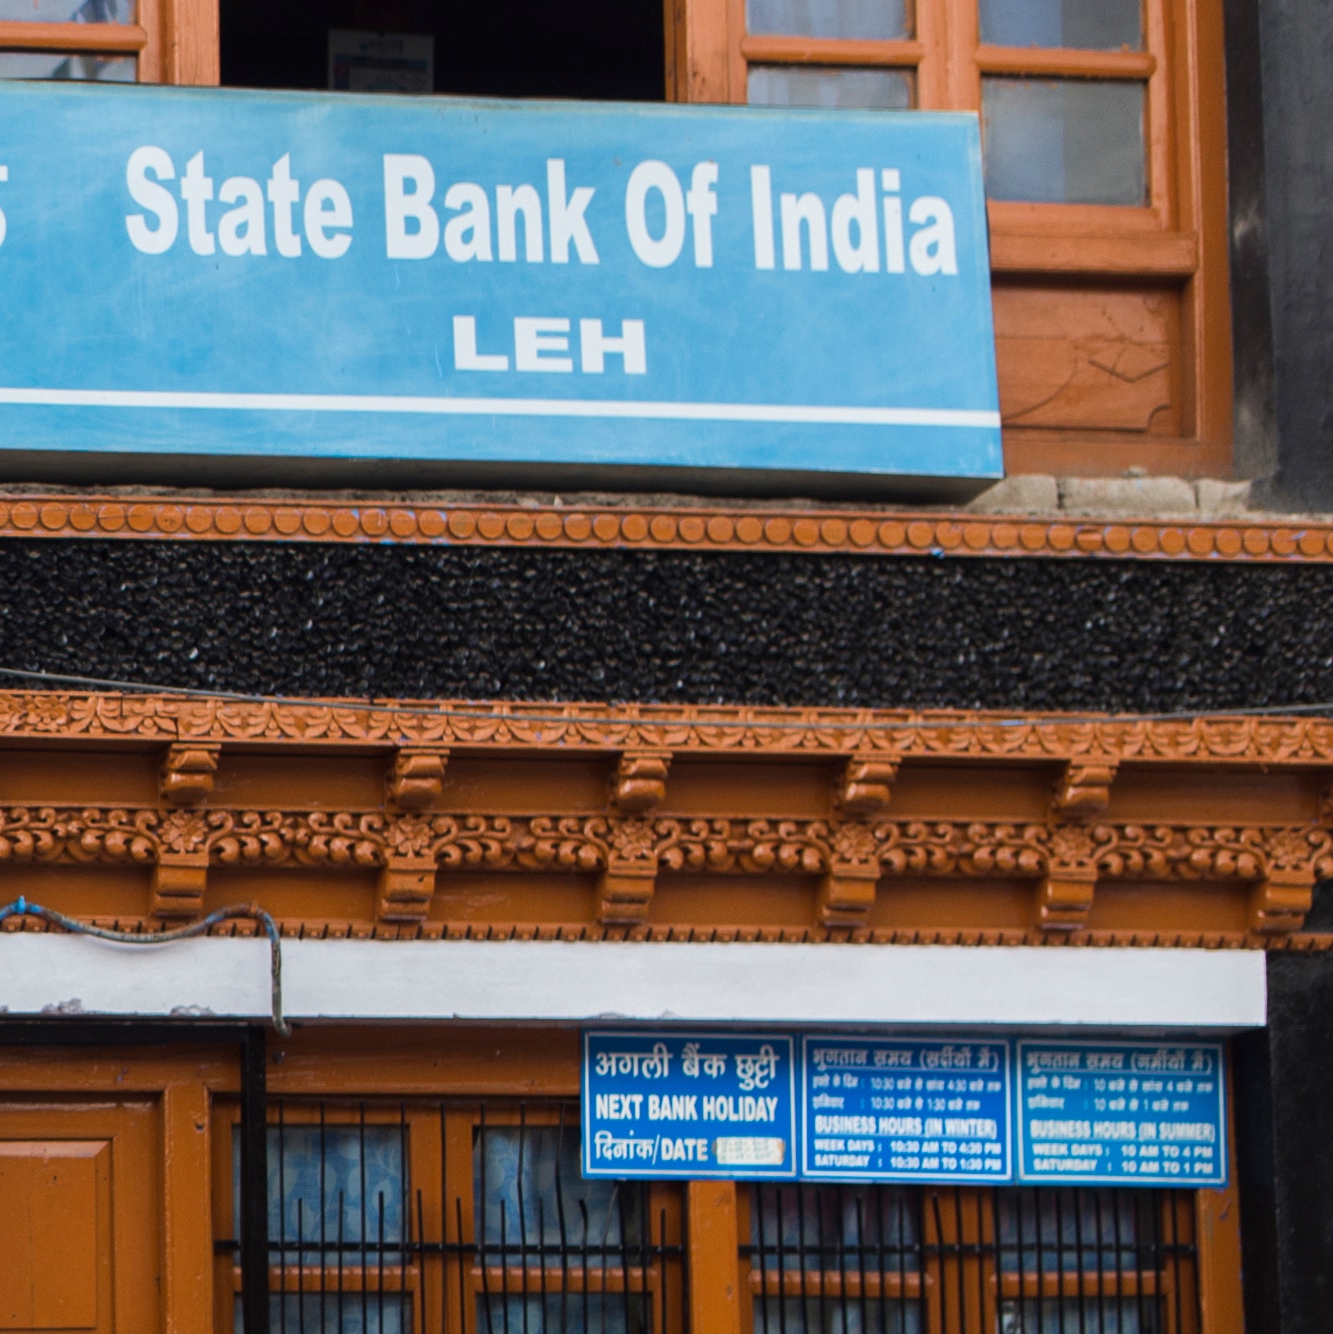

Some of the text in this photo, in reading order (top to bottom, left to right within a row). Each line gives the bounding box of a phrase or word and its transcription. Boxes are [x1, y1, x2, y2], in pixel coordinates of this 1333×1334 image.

[126, 145, 959, 276] State Bank Of India
[453, 316, 647, 376] LEH
[595, 1043, 673, 1078] अगली
[681, 1043, 727, 1079] बैंक
[735, 1044, 780, 1090] छुट्टी
[595, 1094, 778, 1122] NEXT BANK HOLIDAY
[814, 1115, 877, 1135] BUSINESS
[879, 1116, 922, 1136] HOURS
[945, 1118, 998, 1140] WINTER)
[1030, 1119, 1092, 1139] BUSINESS
[1093, 1121, 1137, 1140] HOURS
[814, 1138, 845, 1152] WEEK
[890, 1141, 919, 1154] 10:30
[921, 1141, 940, 1154] AM
[941, 1141, 957, 1154] TO
[959, 1142, 982, 1155] 4:30
[984, 1142, 1002, 1155] PM
[1033, 1143, 1069, 1156] WEEK
[1121, 1145, 1136, 1157] 10
[1139, 1145, 1159, 1158] AM
[1162, 1145, 1180, 1158] TO
[1182, 1146, 1190, 1157] 4
[1194, 1146, 1213, 1158] PM
[814, 1154, 870, 1168] SATURDAY
[890, 1157, 920, 1169] 10:30
[921, 1157, 940, 1170] AM
[941, 1157, 957, 1170] TO
[960, 1158, 982, 1170] 1:30
[984, 1158, 1002, 1171] PM
[1033, 1158, 1097, 1171] SATURDAY
[1121, 1161, 1137, 1173] 10
[1139, 1161, 1159, 1173] AM
[1162, 1161, 1180, 1174] TO
[1194, 1162, 1213, 1174] PM
